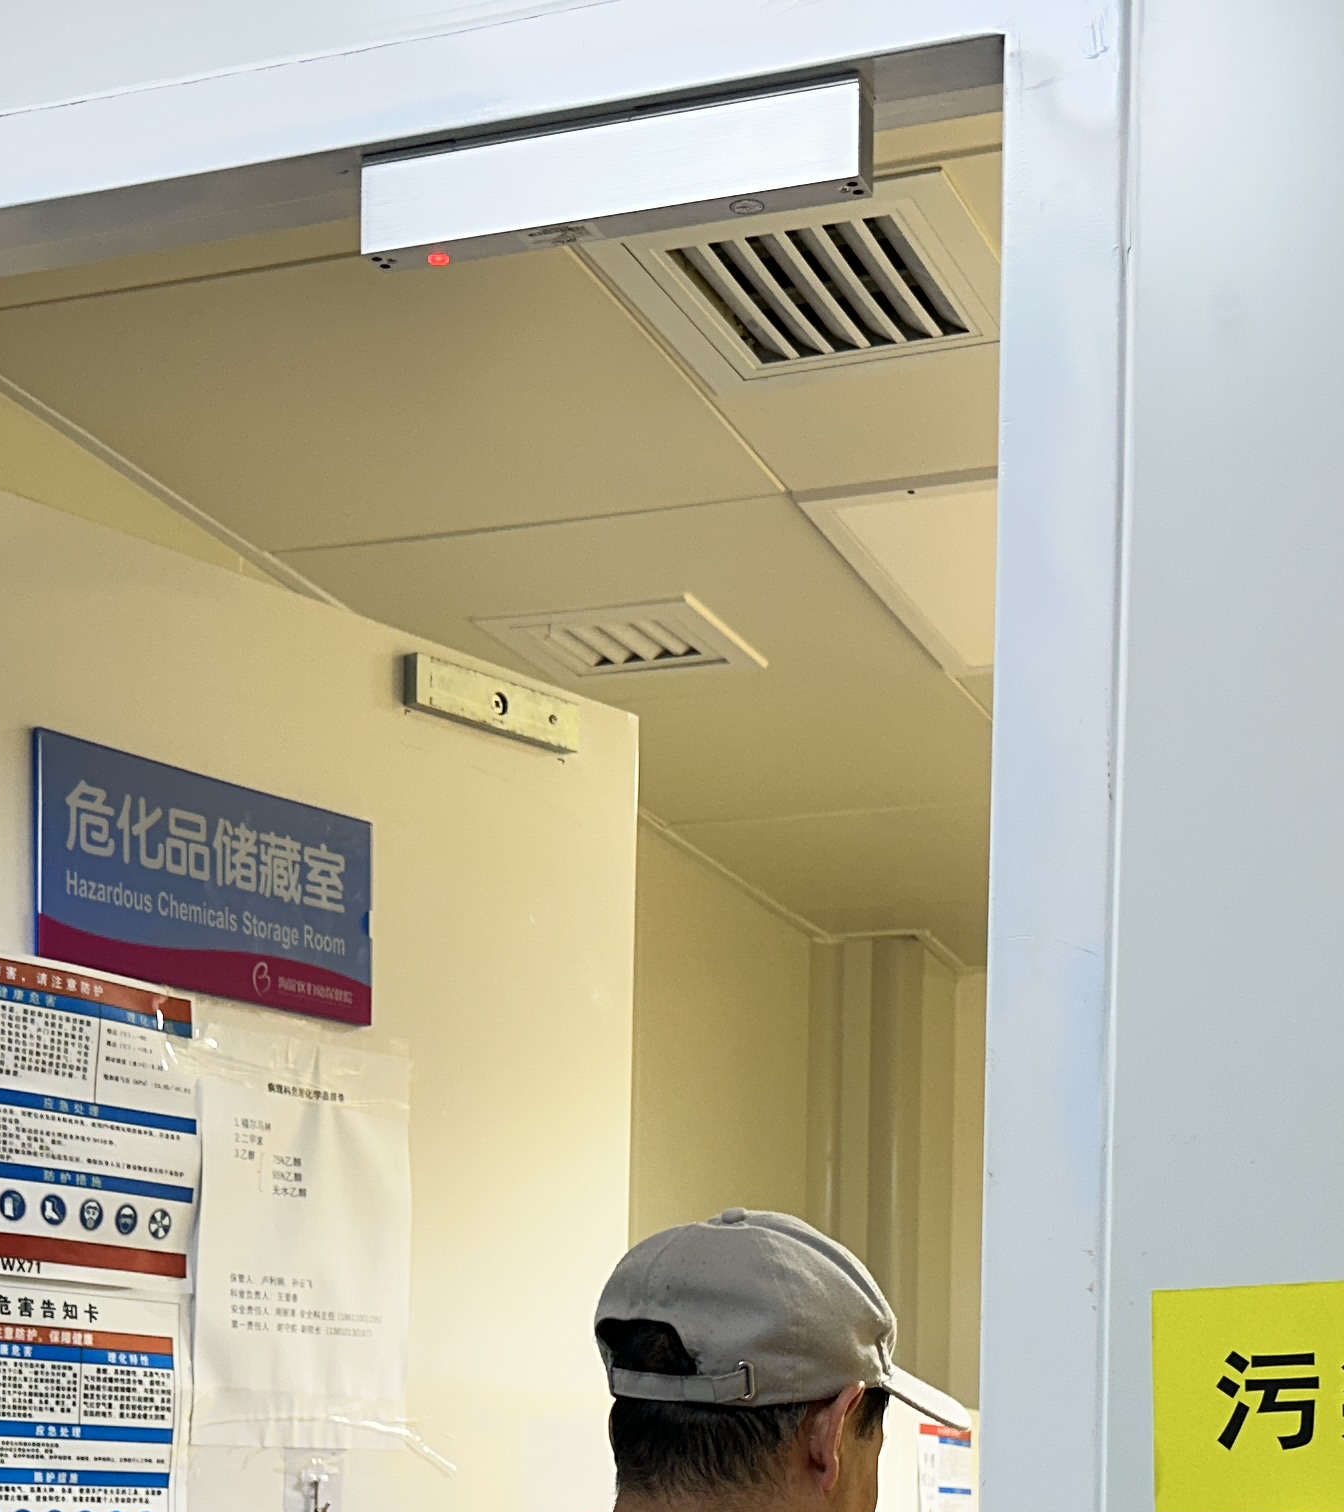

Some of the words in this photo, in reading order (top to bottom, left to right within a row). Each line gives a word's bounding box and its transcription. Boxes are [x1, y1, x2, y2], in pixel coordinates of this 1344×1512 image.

[65, 779, 346, 914] 危化品储藏室
[65, 869, 153, 913] Hazardous
[157, 890, 238, 933] Chemicals
[242, 911, 300, 950] Storage
[303, 924, 346, 956] Room
[1, 1257, 42, 1275] WX71
